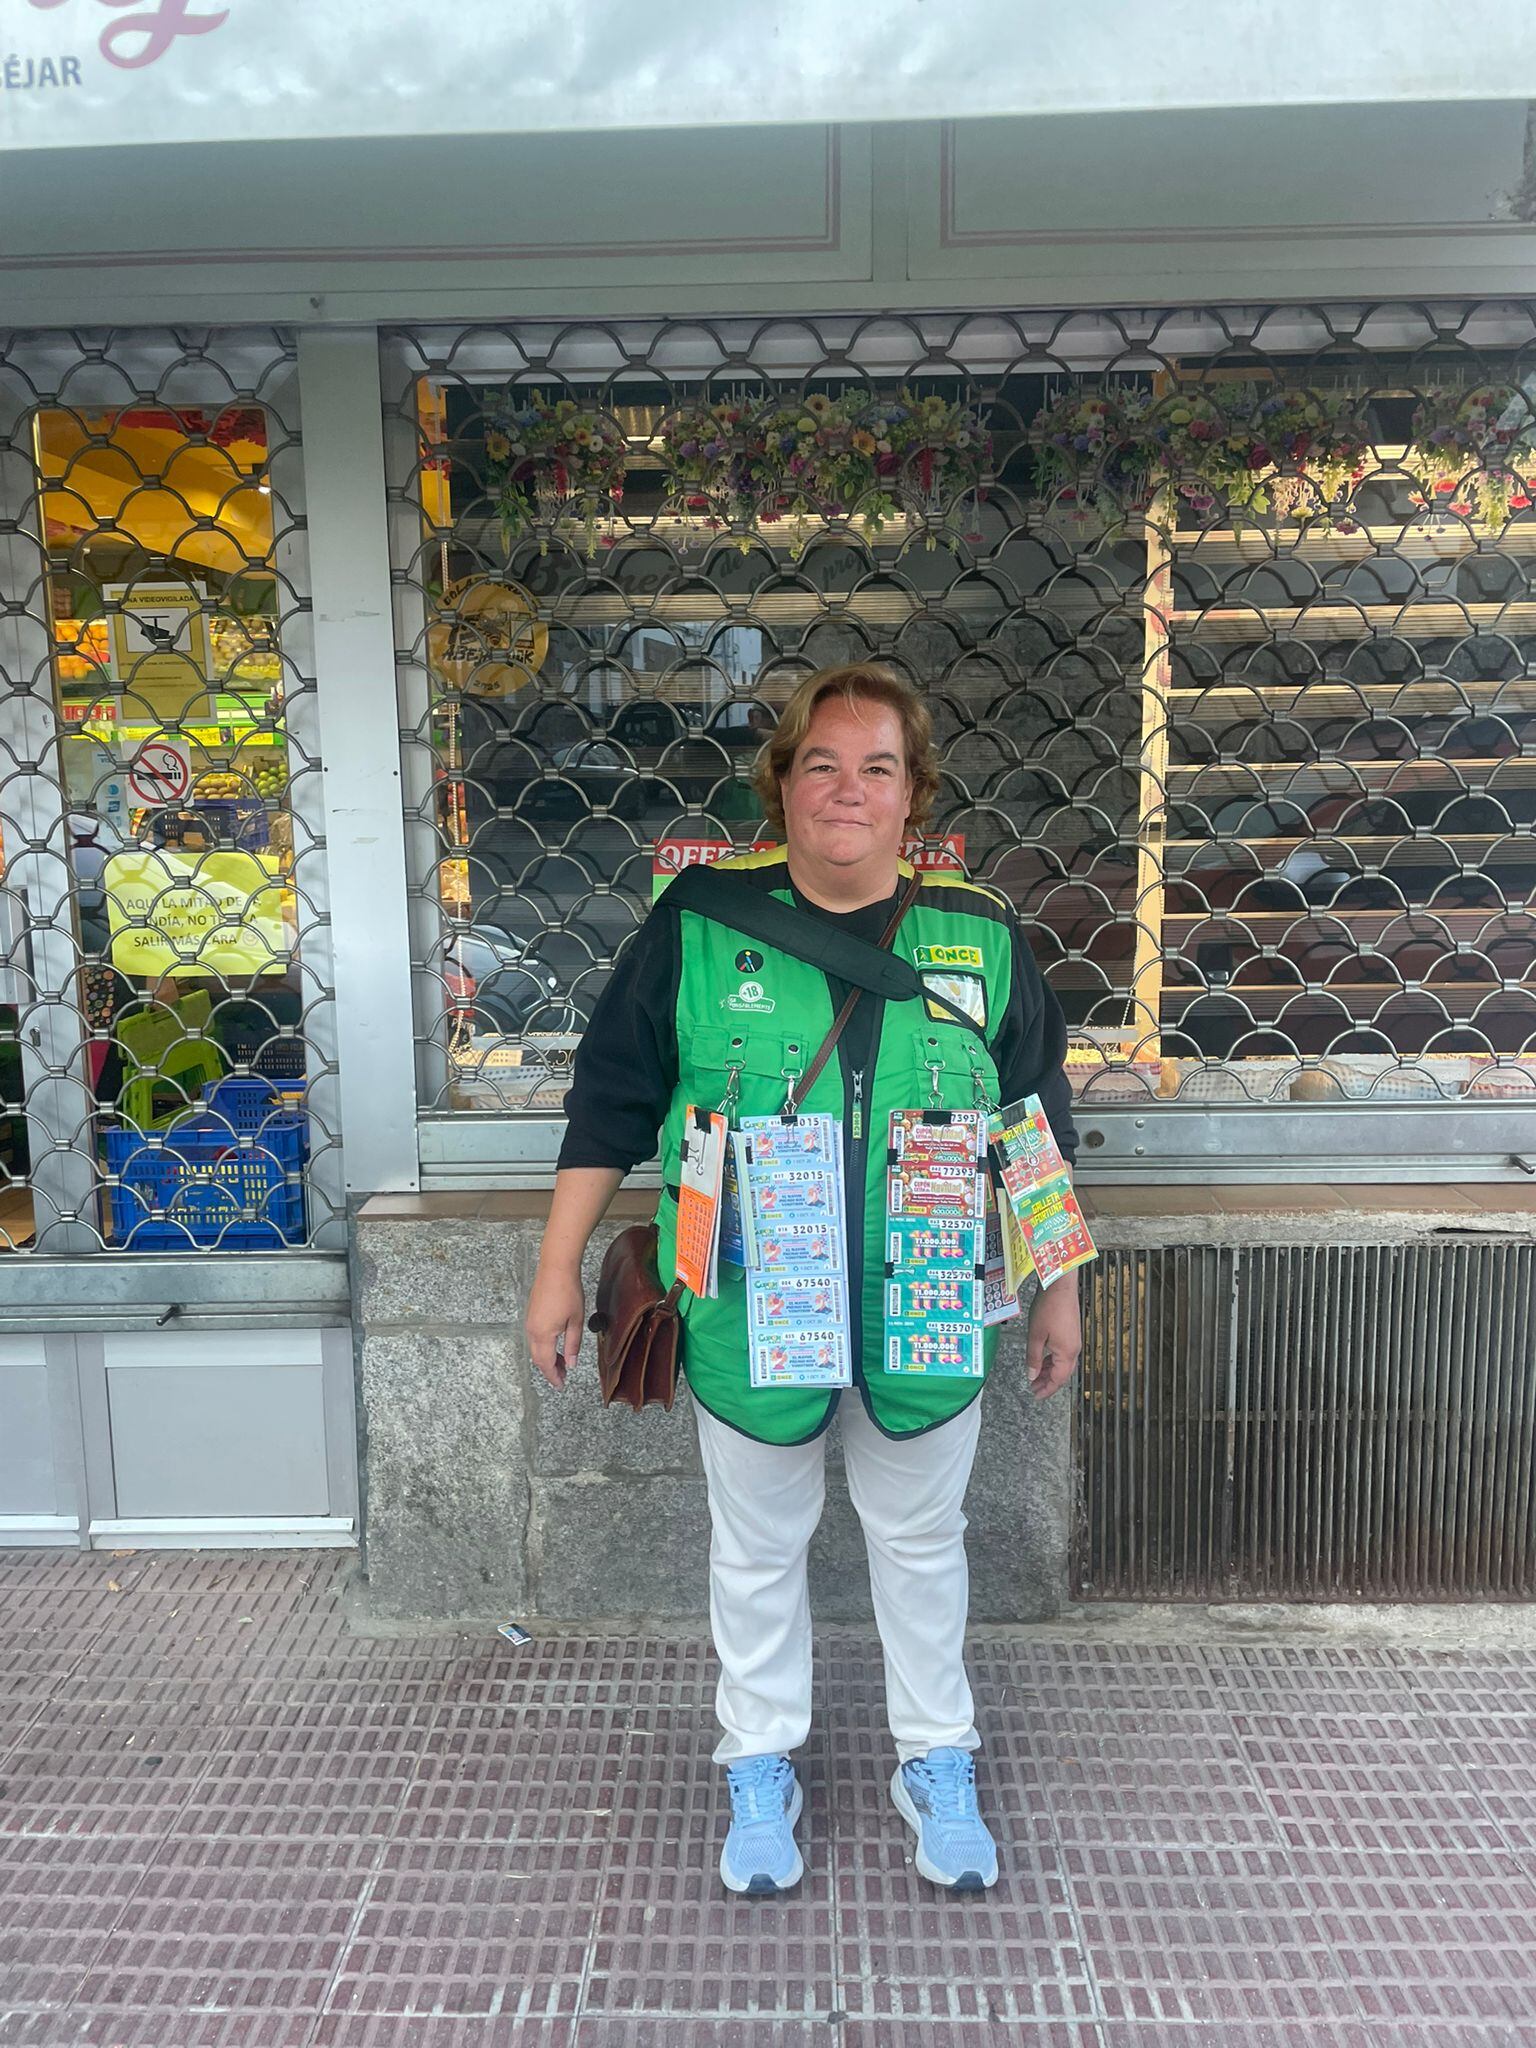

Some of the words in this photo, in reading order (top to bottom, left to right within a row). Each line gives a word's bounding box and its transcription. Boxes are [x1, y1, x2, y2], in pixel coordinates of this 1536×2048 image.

[0, 54, 82, 89] ÉJAR
[127, 898, 158, 910] AQU
[162, 898, 177, 909] LA
[188, 915, 206, 926] NO
[172, 932, 200, 946] MÁS
[934, 949, 977, 963] ONCE
[799, 1117, 819, 1127] 015
[951, 1113, 975, 1122] 7393
[789, 1171, 823, 1181] 32015
[943, 1167, 973, 1176] 77393
[793, 1224, 826, 1235] 32015
[941, 1220, 972, 1229] 32570
[940, 1270, 971, 1280] 32570
[796, 1278, 830, 1288] 67540
[939, 1323, 970, 1333] 32570
[799, 1332, 834, 1341] 67540
